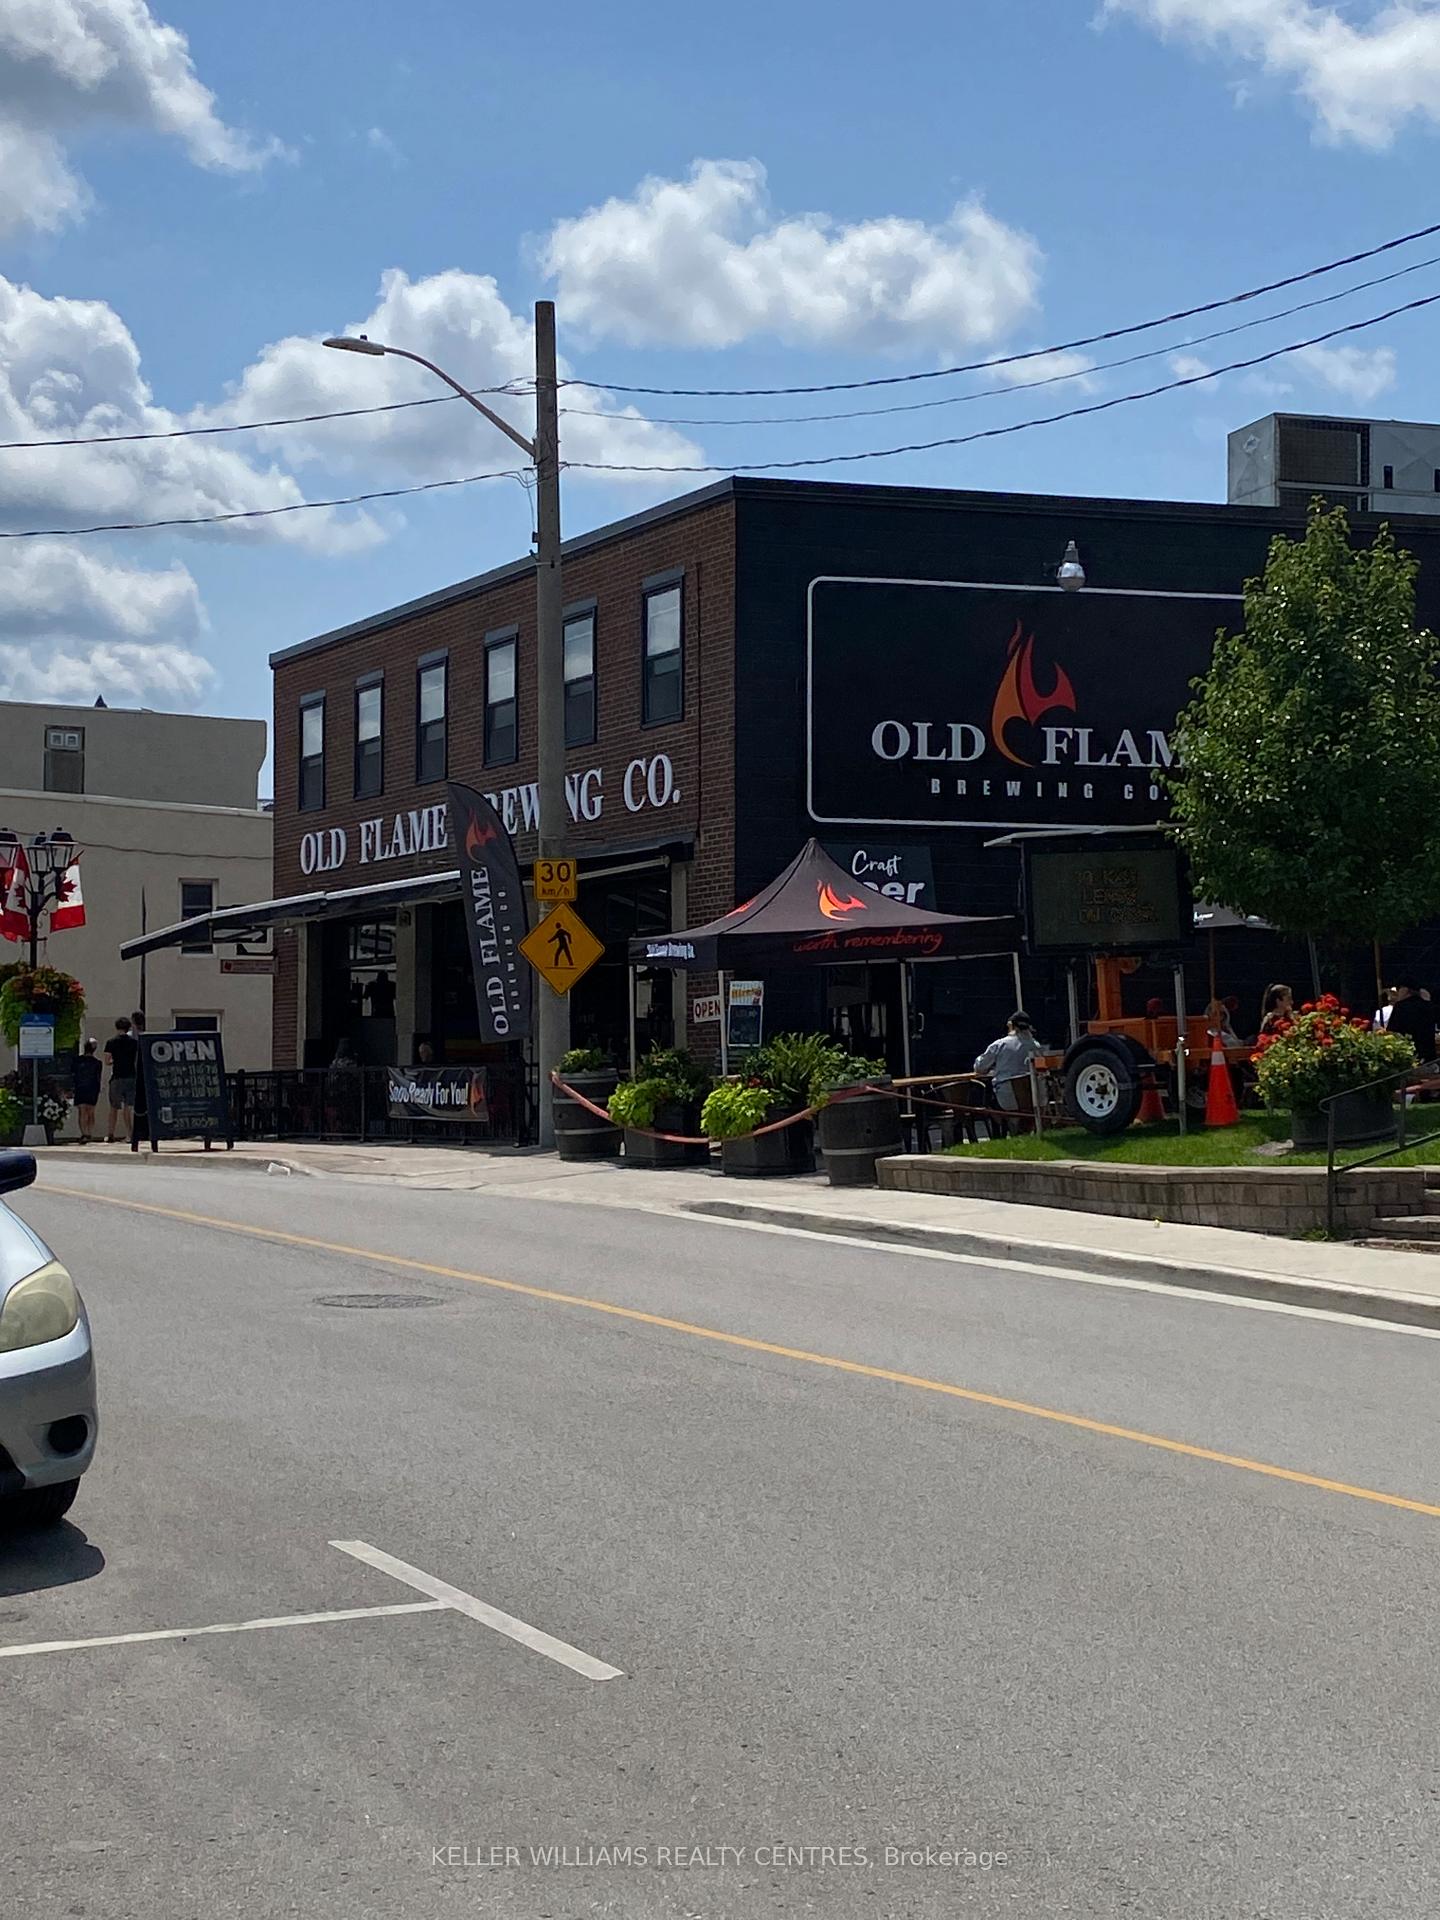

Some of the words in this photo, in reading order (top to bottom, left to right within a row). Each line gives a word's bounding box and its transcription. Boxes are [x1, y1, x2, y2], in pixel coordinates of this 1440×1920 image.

[871, 720, 986, 762] OLD
[1041, 727, 1185, 768] FLAM
[931, 778, 1094, 799] BREWING
[1124, 784, 1169, 801] CO.
[300, 827, 348, 876] OLD
[359, 804, 449, 865] FLAME
[623, 753, 681, 813] CO.
[541, 862, 570, 883] 30
[851, 849, 903, 877] Craft
[541, 884, 570, 897] km/h
[863, 881, 926, 904] er
[470, 866, 502, 967] FLAME
[791, 928, 838, 954] worth
[844, 927, 945, 954] remembering
[485, 976, 510, 1035] OLD
[694, 999, 721, 1018] OPEN
[150, 1039, 217, 1063] OPEN
[409, 1081, 435, 1109] Ready
[435, 1081, 450, 1105] For
[450, 1081, 469, 1105] You!
